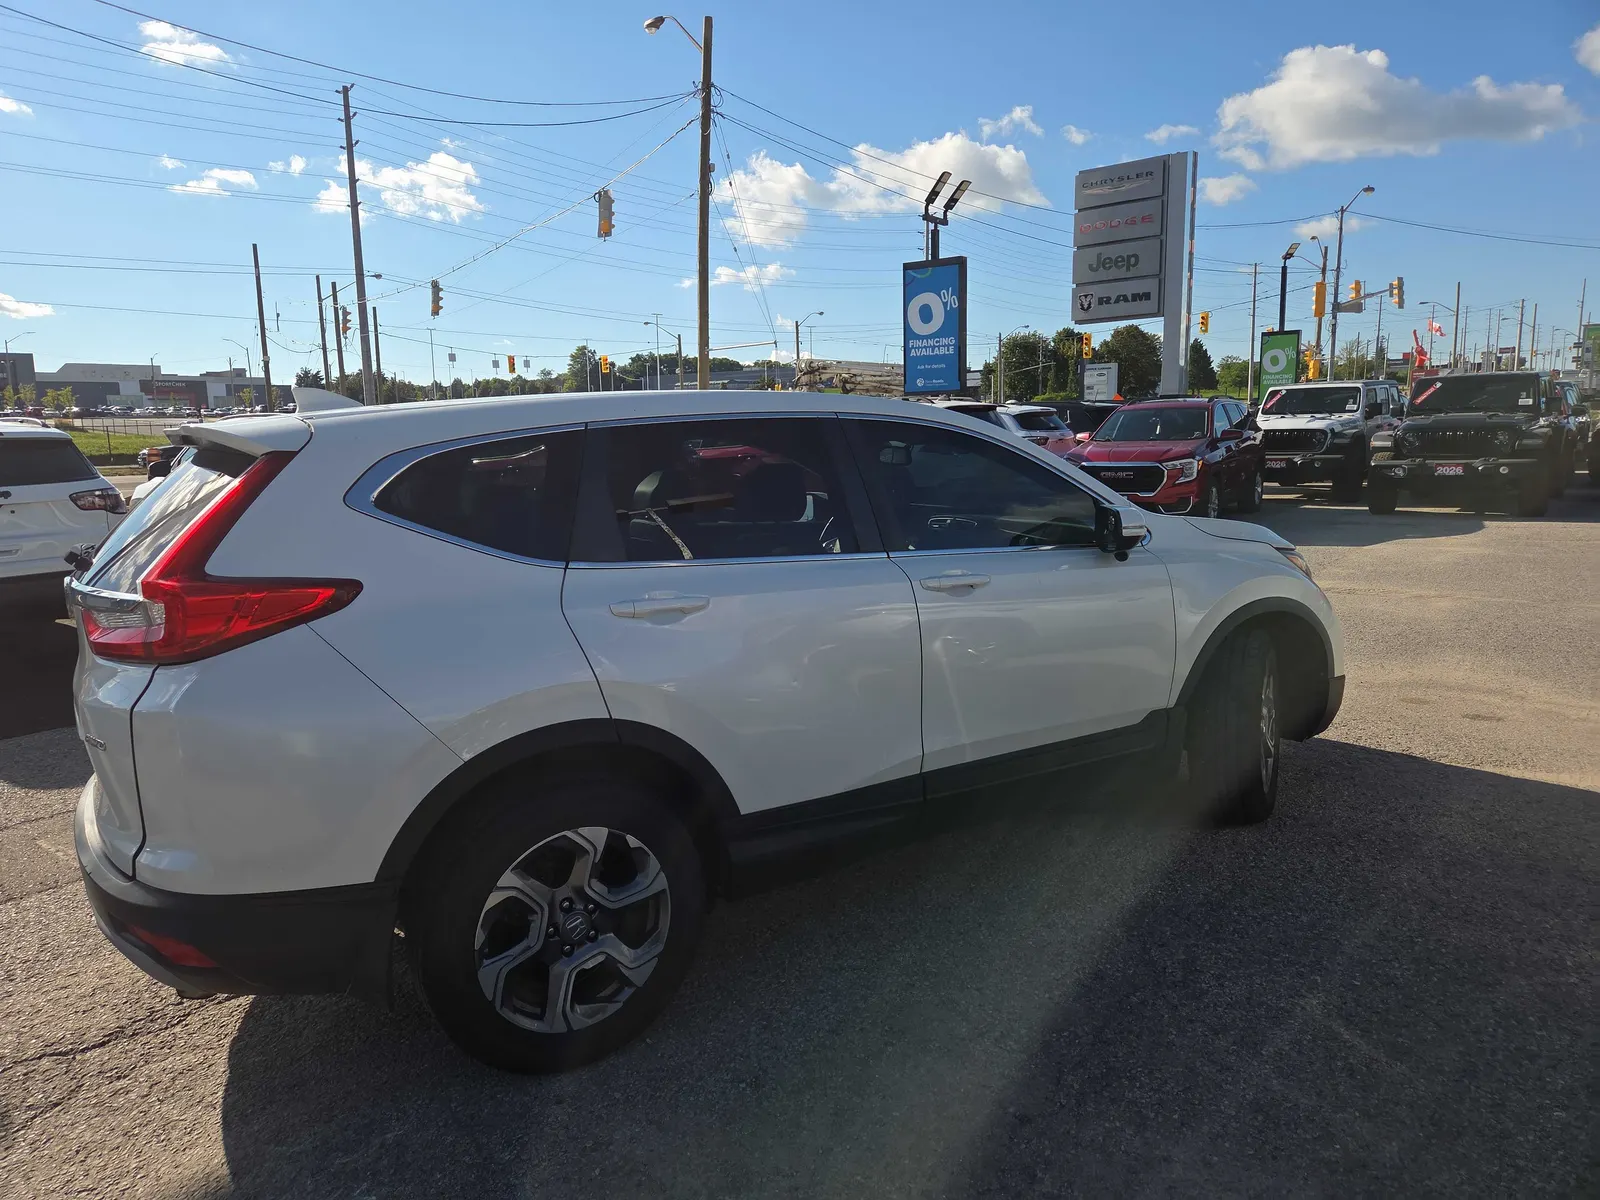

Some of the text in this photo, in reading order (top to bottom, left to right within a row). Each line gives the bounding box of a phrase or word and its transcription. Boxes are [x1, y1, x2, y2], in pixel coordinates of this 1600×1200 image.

[1082, 170, 1155, 189] CHRYSLER
[1079, 213, 1155, 235] DODGE
[1088, 252, 1140, 273] Jeep
[1097, 291, 1151, 306] RAM
[909, 336, 956, 348] FINANCING
[910, 346, 955, 357] AVAILABLE
[1099, 471, 1134, 479] GMC
[1437, 466, 1464, 474] 2026
